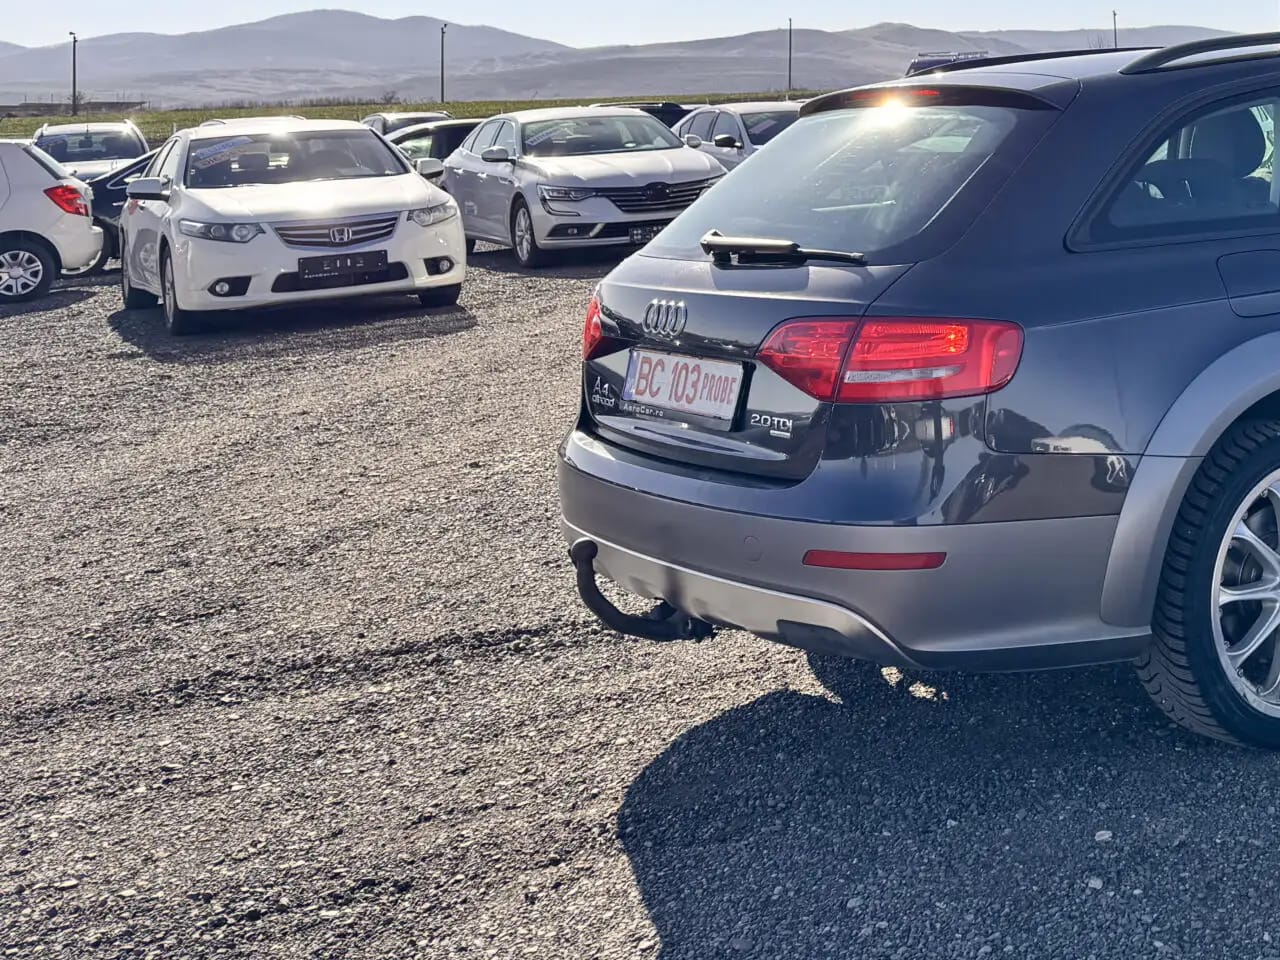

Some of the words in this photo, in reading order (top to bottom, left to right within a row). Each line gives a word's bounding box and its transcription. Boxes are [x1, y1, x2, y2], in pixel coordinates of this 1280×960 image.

[593, 376, 609, 397] A4
[635, 356, 665, 398] BC
[668, 361, 702, 404] 103
[700, 373, 738, 405] PROBE
